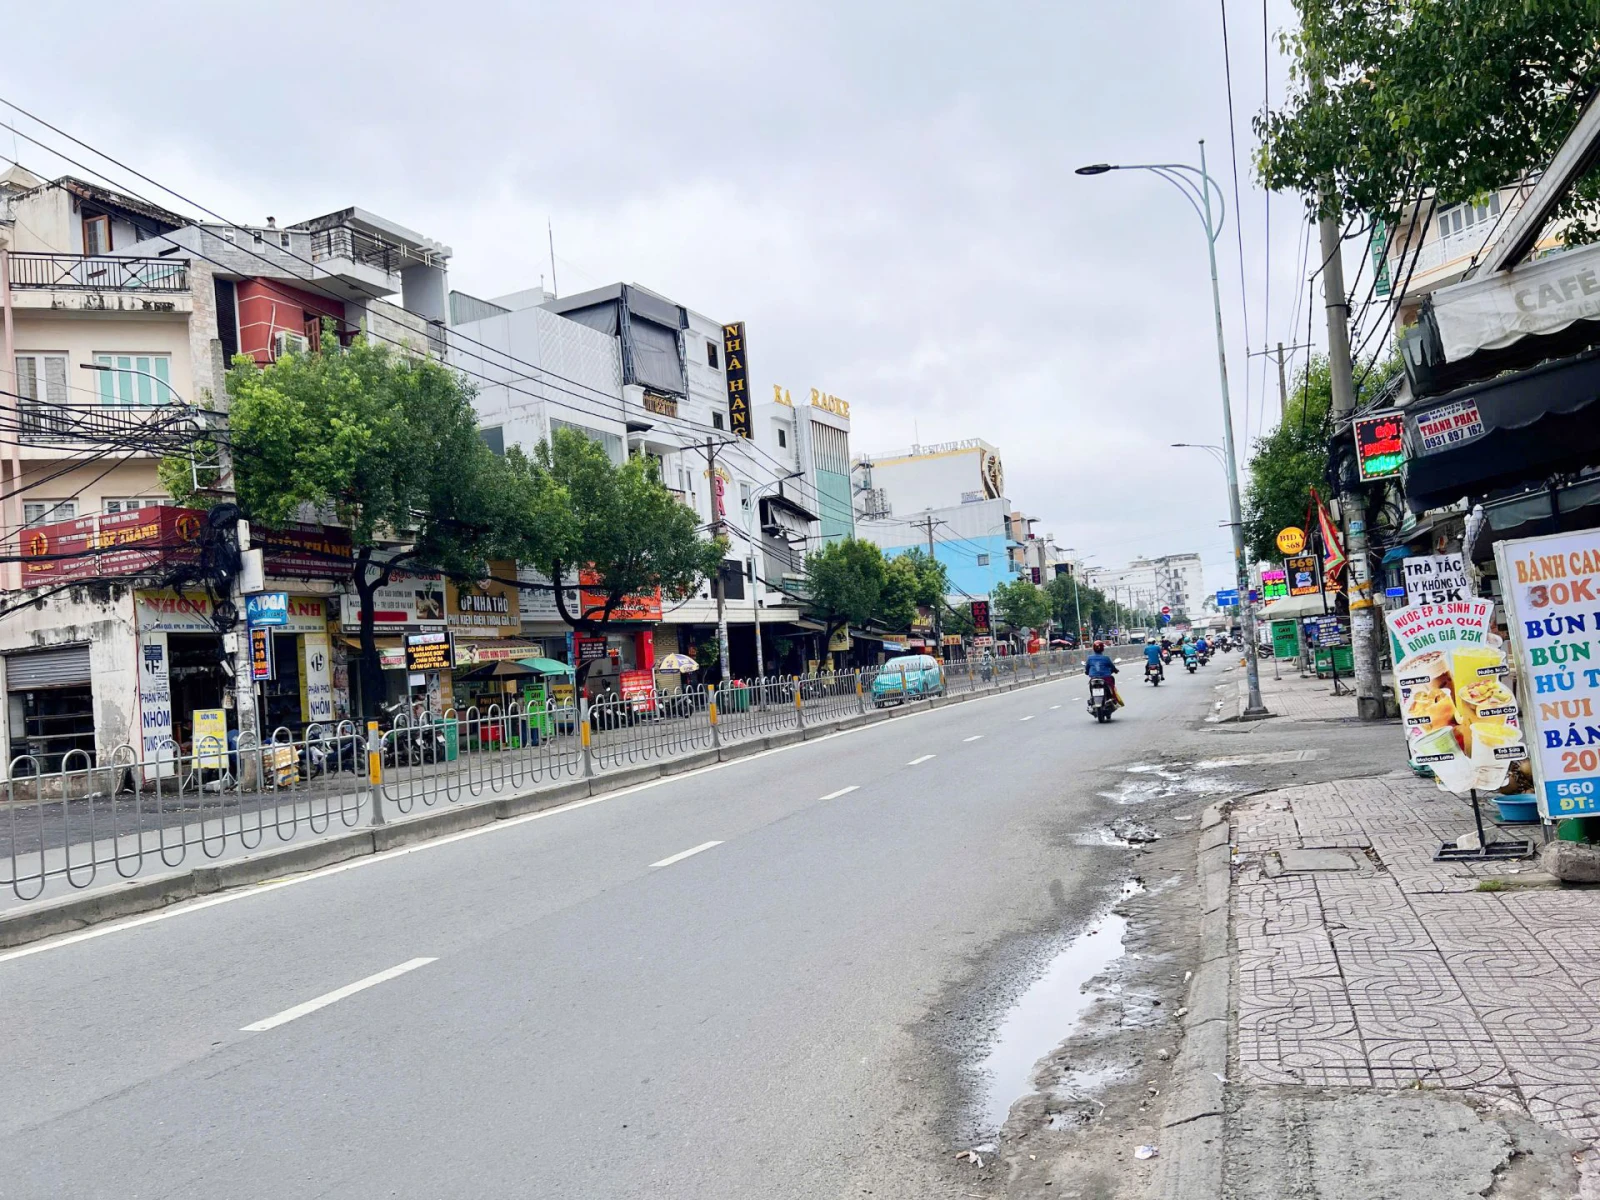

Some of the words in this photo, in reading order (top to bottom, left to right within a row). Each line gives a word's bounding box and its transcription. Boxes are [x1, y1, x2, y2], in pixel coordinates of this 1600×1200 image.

[725, 324, 743, 371] NHÀ
[773, 384, 793, 407] KA
[729, 378, 747, 438] HÀNG
[912, 438, 980, 455] RESTAURANT
[1424, 434, 1447, 449] 0931
[1447, 429, 1464, 442] 897
[1467, 423, 1483, 436] 162
[1286, 542, 1300, 550] 568
[1289, 557, 1314, 569] 568
[1405, 560, 1432, 576] TRÀ
[1436, 556, 1462, 573] TẮC
[1515, 552, 1567, 584] BÁNH
[1408, 581, 1419, 593] LY
[1418, 588, 1463, 605] 15K
[256, 595, 286, 611] YOGA
[1394, 610, 1420, 629] NƯỚC
[1437, 603, 1444, 614] &
[1447, 603, 1470, 614] SINH
[1525, 612, 1584, 640] BÚN
[1402, 622, 1425, 638] TRÀ
[1426, 617, 1453, 628] HOA
[1439, 627, 1457, 641] GIÁ
[1460, 630, 1483, 643] 25K
[1530, 639, 1590, 667] BÚN
[1535, 664, 1575, 694] HỦ
[310, 697, 331, 715] NHÔM
[1539, 697, 1594, 721] NUI
[143, 706, 170, 728] NHÔM
[1557, 781, 1594, 796] 560
[1560, 797, 1594, 811] ĐT:
